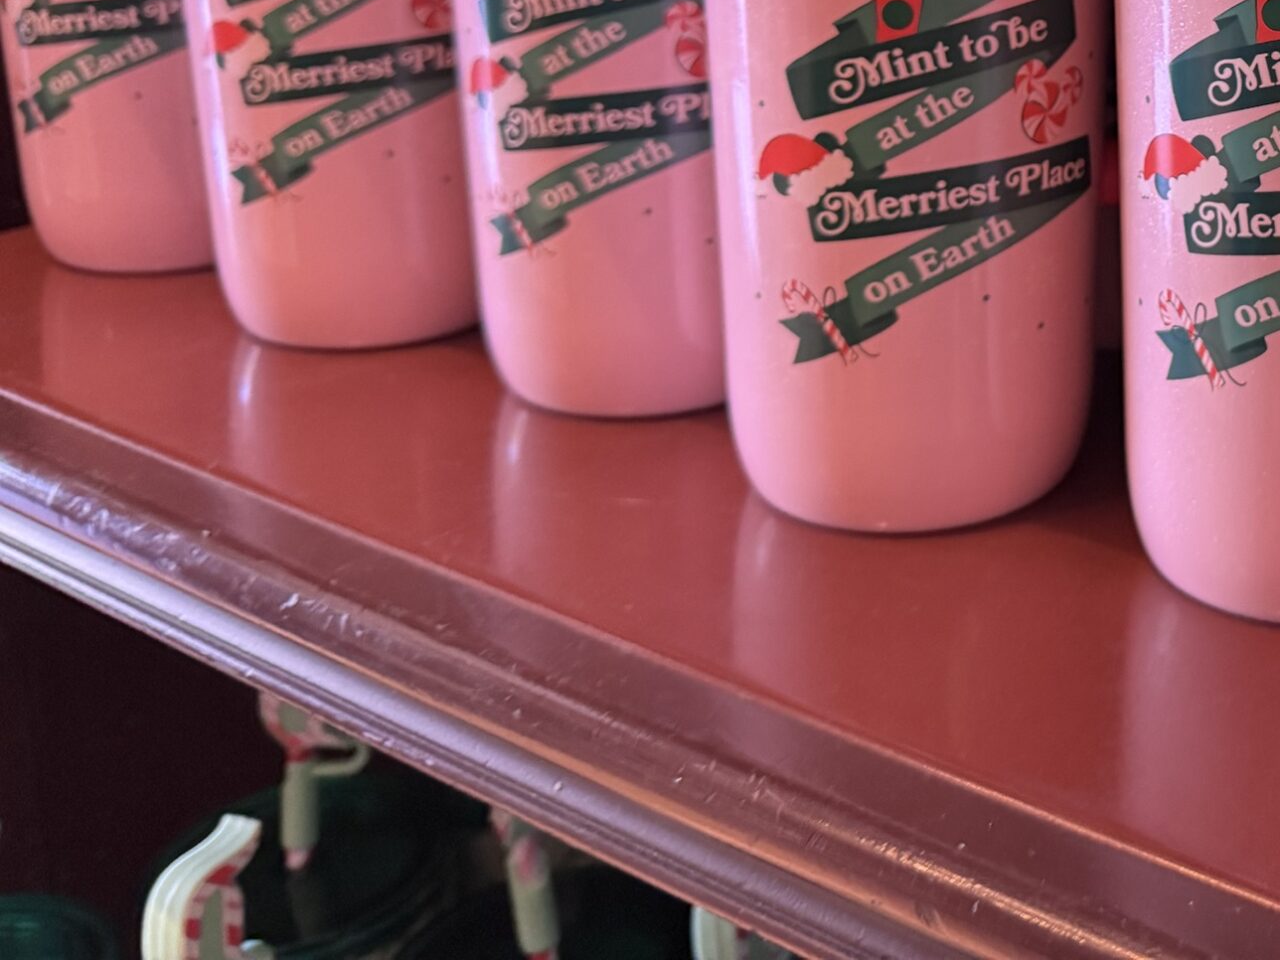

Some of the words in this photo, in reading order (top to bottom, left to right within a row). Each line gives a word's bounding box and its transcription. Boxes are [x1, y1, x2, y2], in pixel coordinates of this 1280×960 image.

[20, 6, 140, 44] Merriest
[285, 7, 318, 33] at
[543, 46, 574, 77] at
[574, 21, 628, 59] the
[50, 70, 72, 93] on
[77, 37, 159, 79] Earth
[244, 53, 397, 102] Merriest
[829, 48, 951, 104] Mint
[959, 31, 998, 60] to
[990, 15, 1048, 50] be
[285, 129, 323, 157] on
[320, 88, 414, 139] Earth
[504, 102, 656, 148] Merriest
[876, 122, 915, 151] at
[917, 83, 975, 130] the
[543, 184, 578, 210] on
[576, 139, 675, 187] Earth
[815, 180, 1000, 236] Merriest
[1005, 154, 1085, 198] Place
[863, 270, 912, 303] on
[909, 215, 1015, 282] Earth
